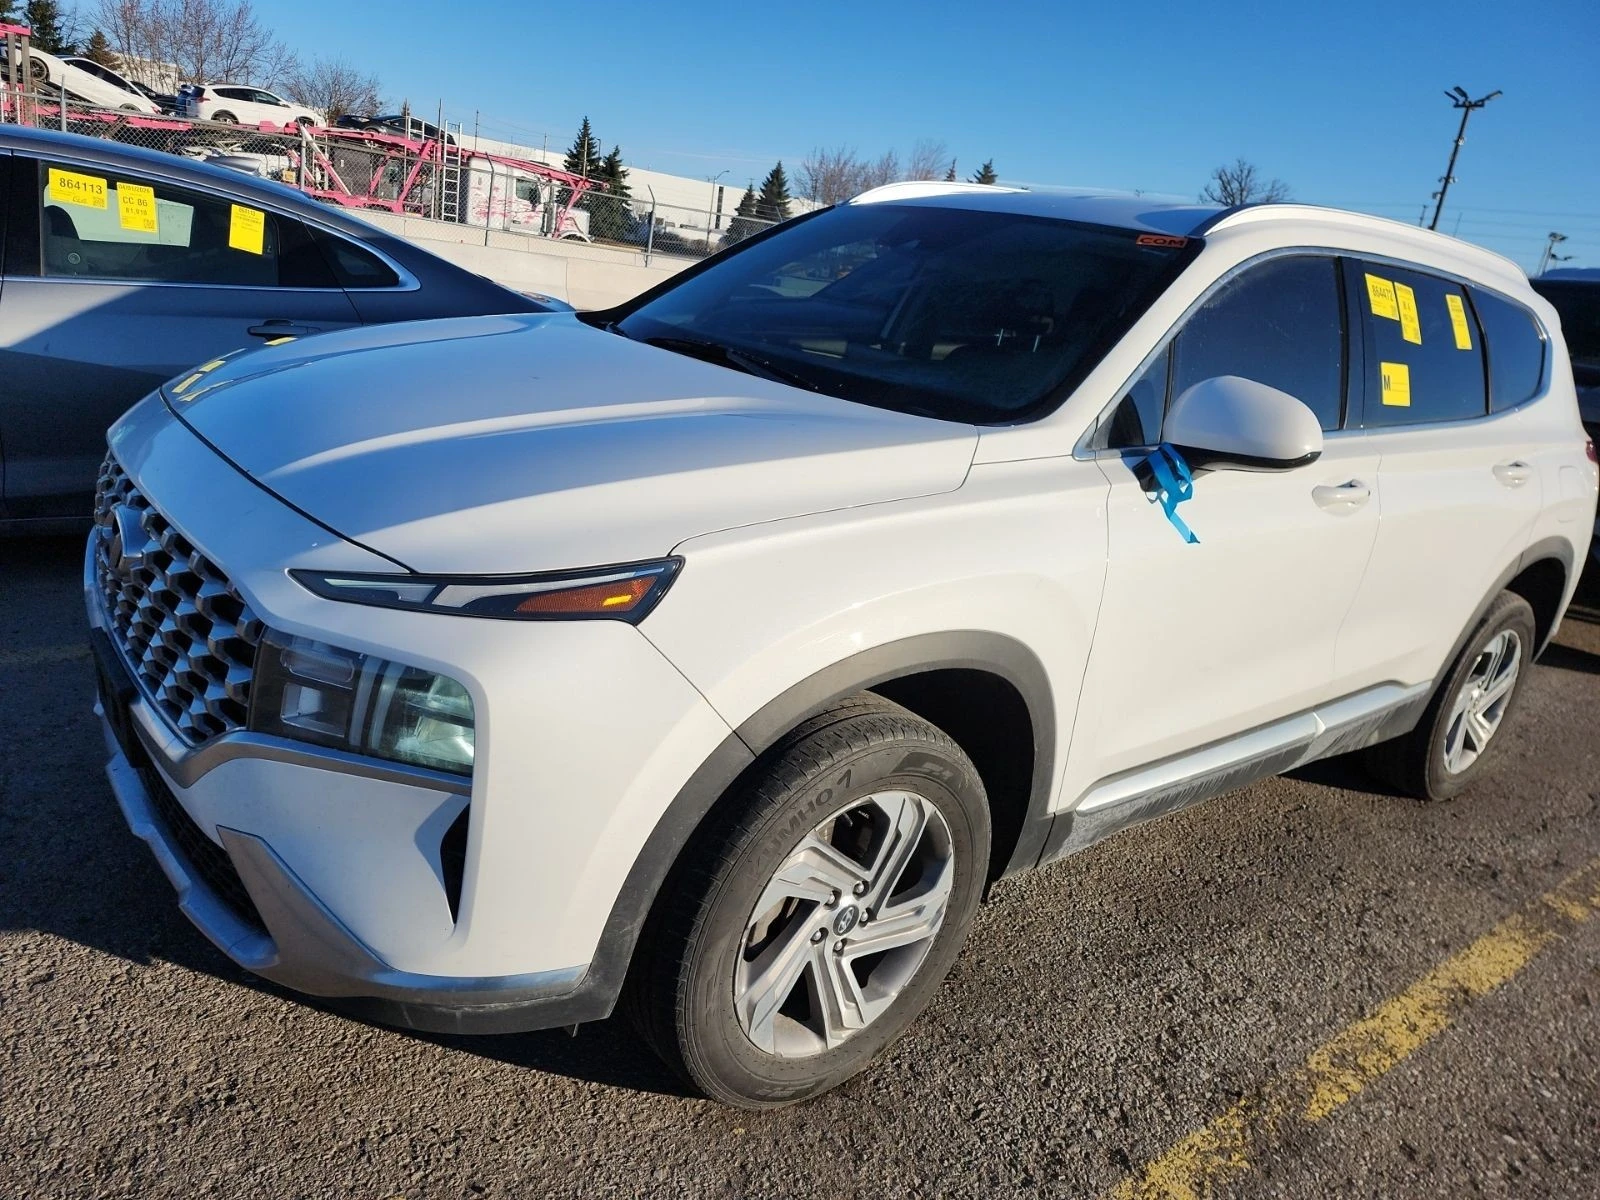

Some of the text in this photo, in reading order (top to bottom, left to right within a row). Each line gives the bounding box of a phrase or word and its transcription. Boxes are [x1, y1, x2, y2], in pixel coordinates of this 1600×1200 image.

[59, 177, 103, 194] 864113
[123, 196, 134, 204] CC
[1140, 237, 1185, 246] COM
[1383, 374, 1391, 391] M
